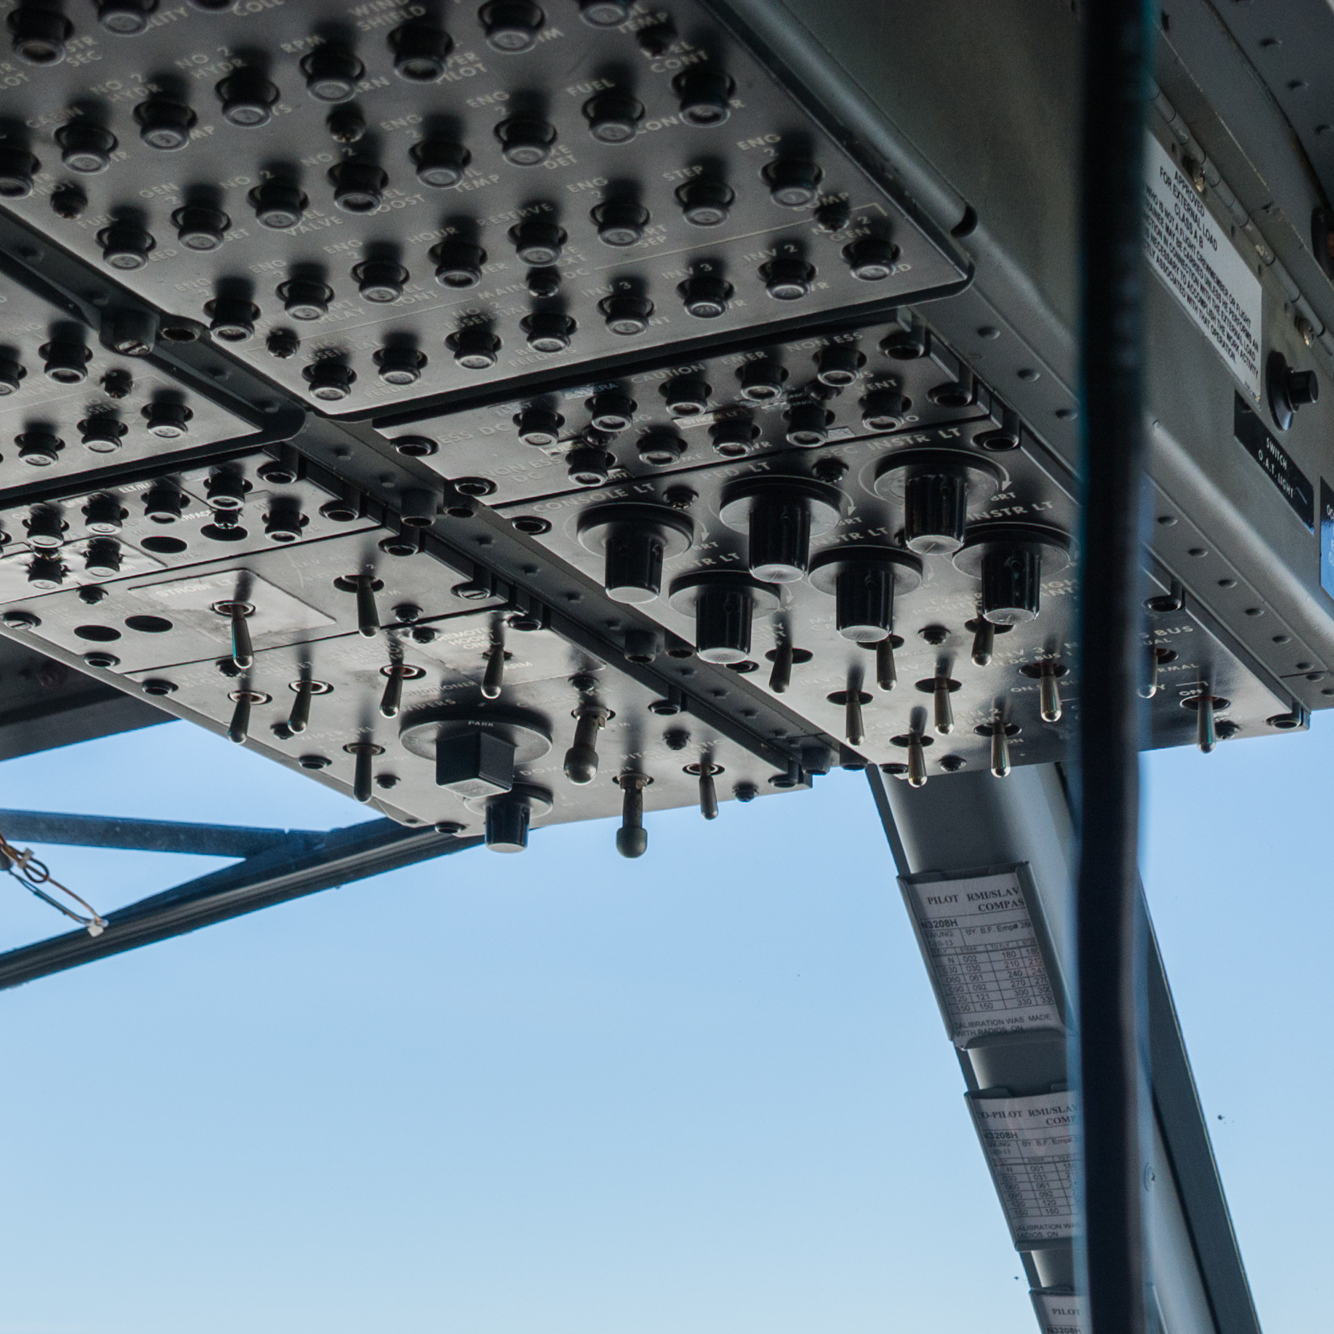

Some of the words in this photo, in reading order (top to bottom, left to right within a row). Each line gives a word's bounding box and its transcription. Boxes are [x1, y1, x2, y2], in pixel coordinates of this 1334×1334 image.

[663, 165, 704, 181] STEP
[1174, 171, 1204, 217] APPROVED
[1160, 166, 1172, 186] FOR
[1173, 185, 1201, 231] EXTERNAL
[1203, 229, 1217, 251] LOAD
[867, 434, 930, 450] INSTR
[938, 427, 962, 439] LT
[1267, 438, 1287, 471] SWITCH
[533, 486, 626, 513] CONSOLE
[629, 482, 656, 496] LT
[1278, 476, 1293, 498] LIGHT
[928, 895, 958, 904] PILOT
[921, 919, 958, 929] N3208H
